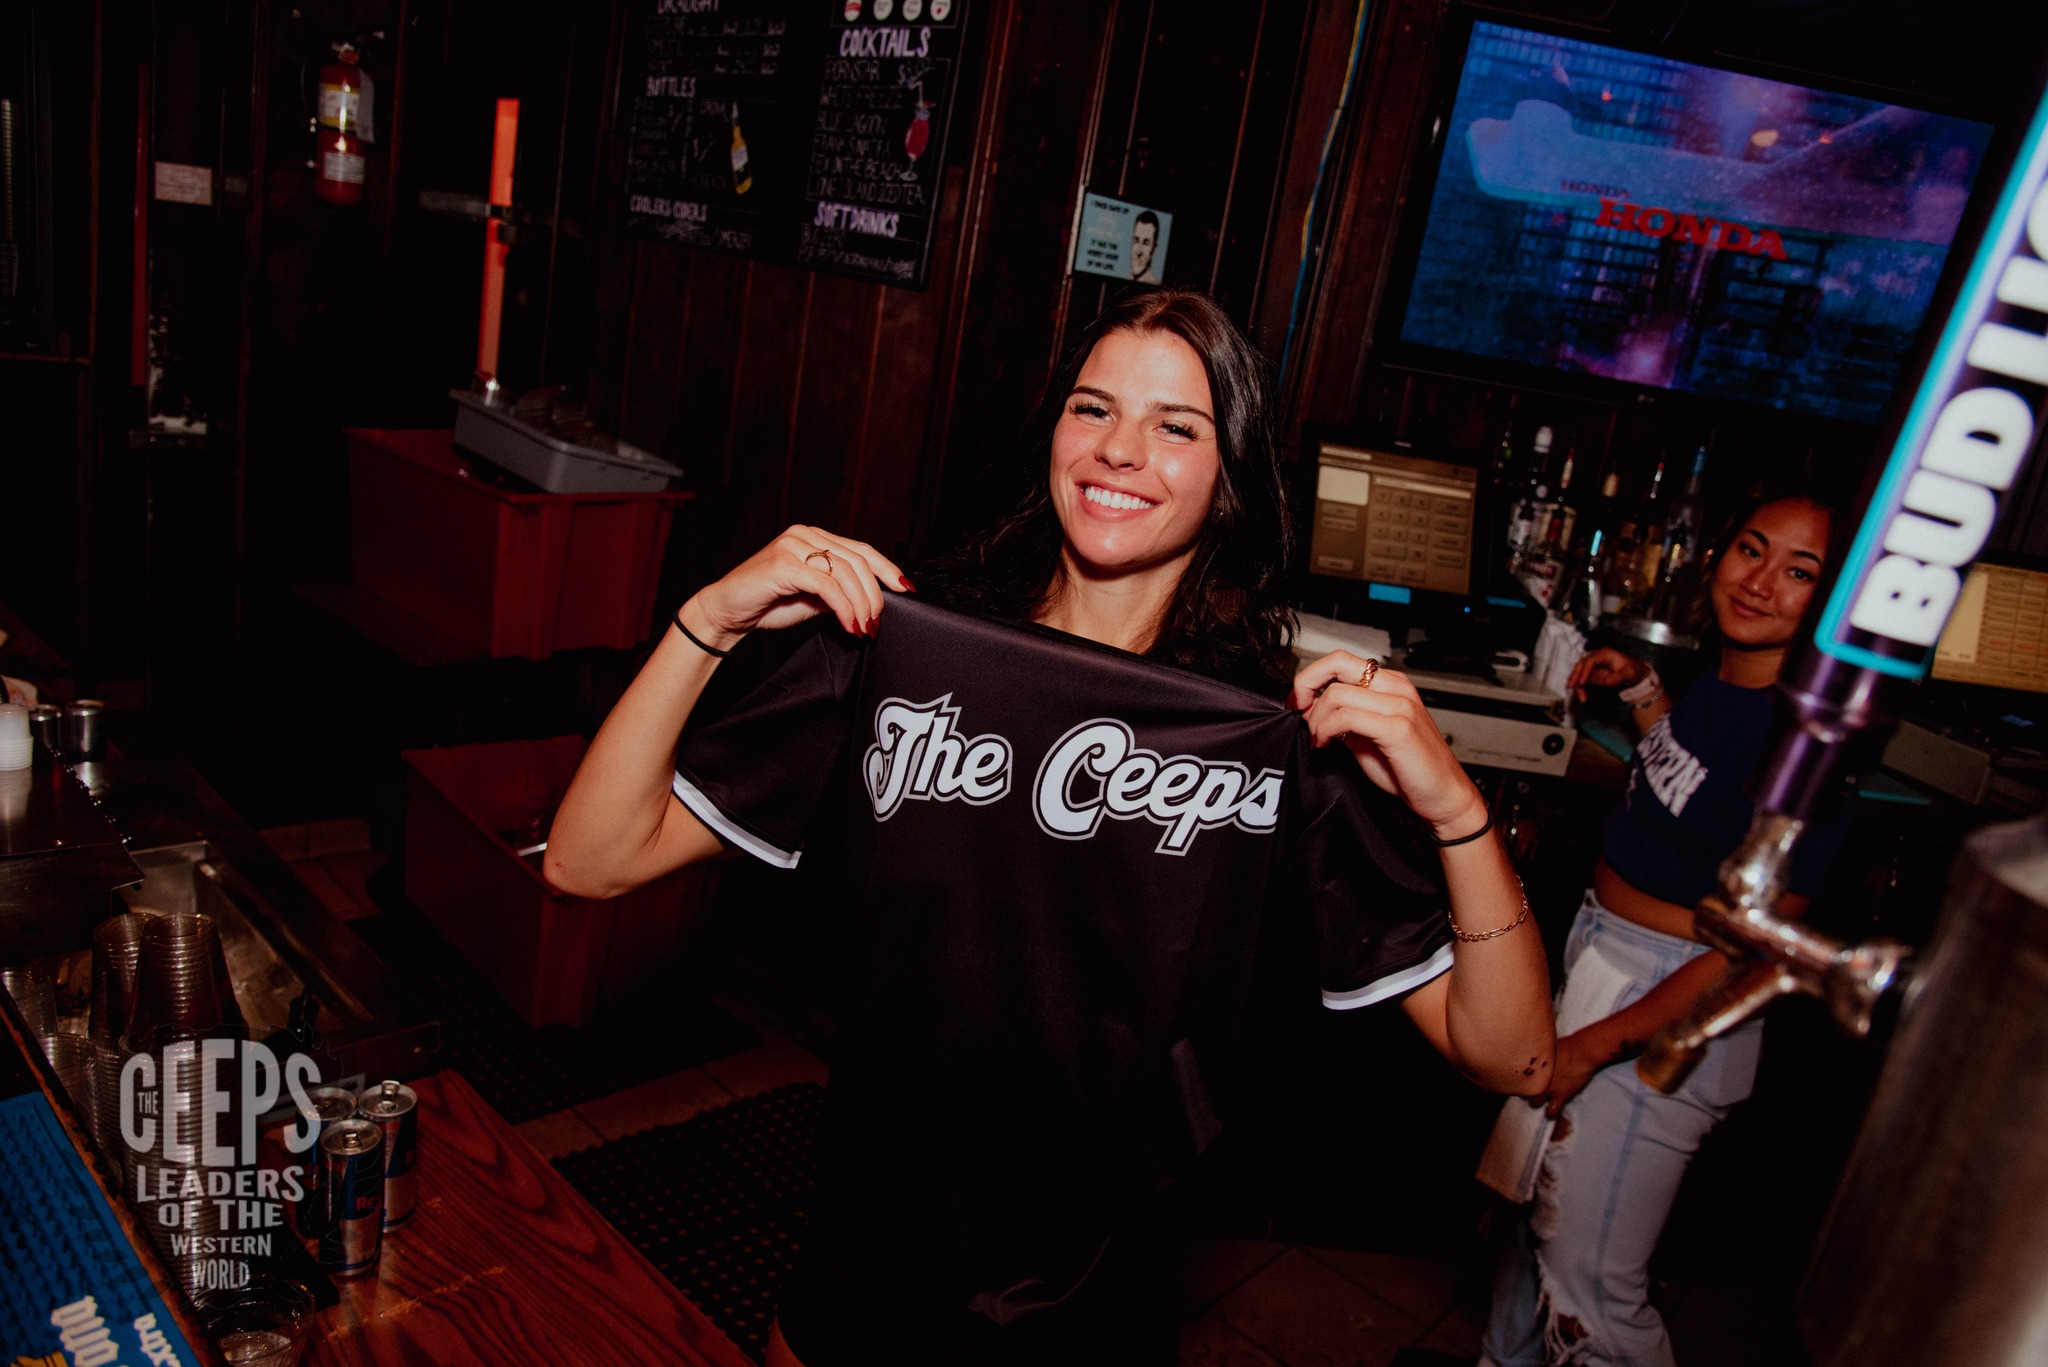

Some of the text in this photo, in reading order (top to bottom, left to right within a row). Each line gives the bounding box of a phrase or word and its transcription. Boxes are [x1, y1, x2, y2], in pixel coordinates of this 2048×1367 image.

[839, 26, 931, 58] COCKTAILS
[645, 74, 697, 98] BOTTLES
[1561, 180, 1631, 199] HONDA
[813, 200, 850, 231] SOFT
[849, 206, 901, 238] DRINKS
[1594, 197, 1789, 262] HONDA
[1849, 386, 2036, 648] BUD
[862, 691, 1286, 857] The Ceeps
